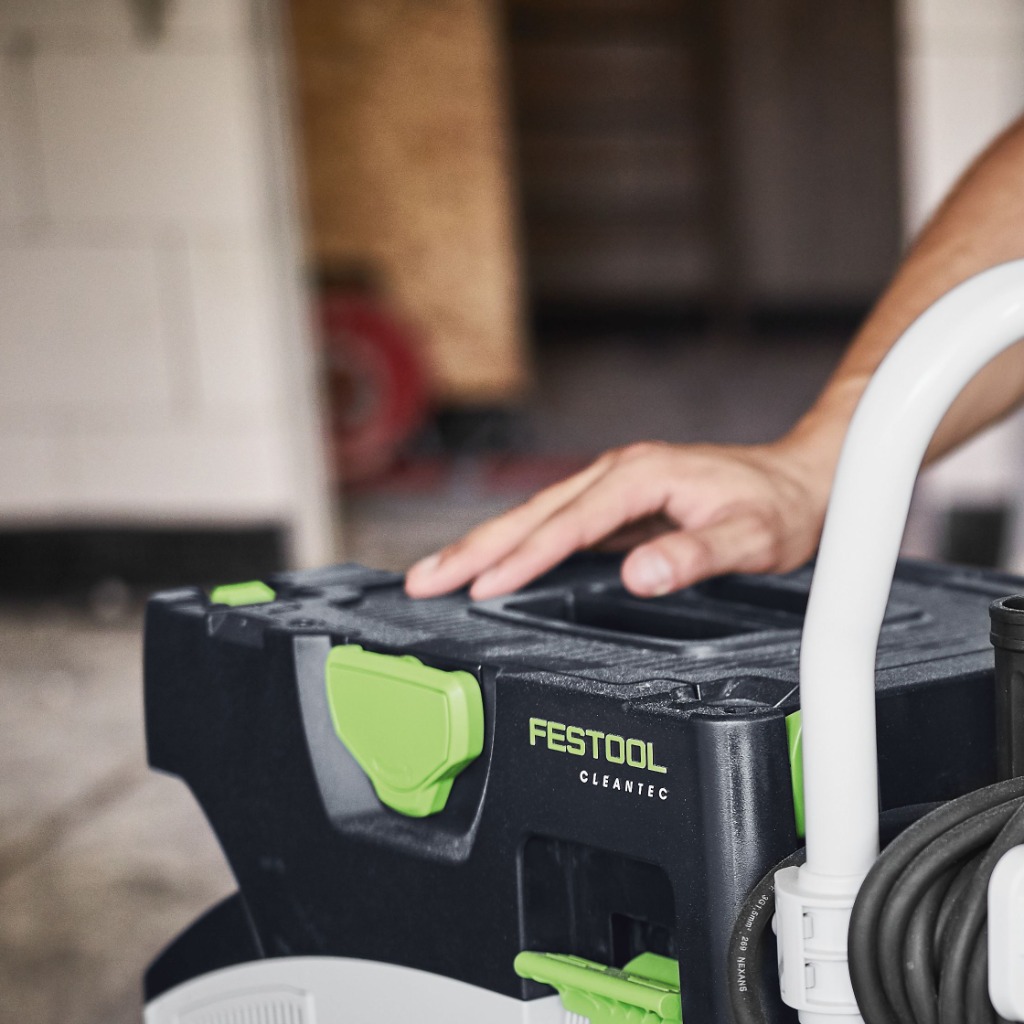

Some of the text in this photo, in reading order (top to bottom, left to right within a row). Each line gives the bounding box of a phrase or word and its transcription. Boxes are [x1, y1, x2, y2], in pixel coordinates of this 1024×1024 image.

[529, 717, 668, 774] FESTOOL
[579, 770, 669, 800] CLEANTEC
[736, 956, 748, 992] NEXANS
